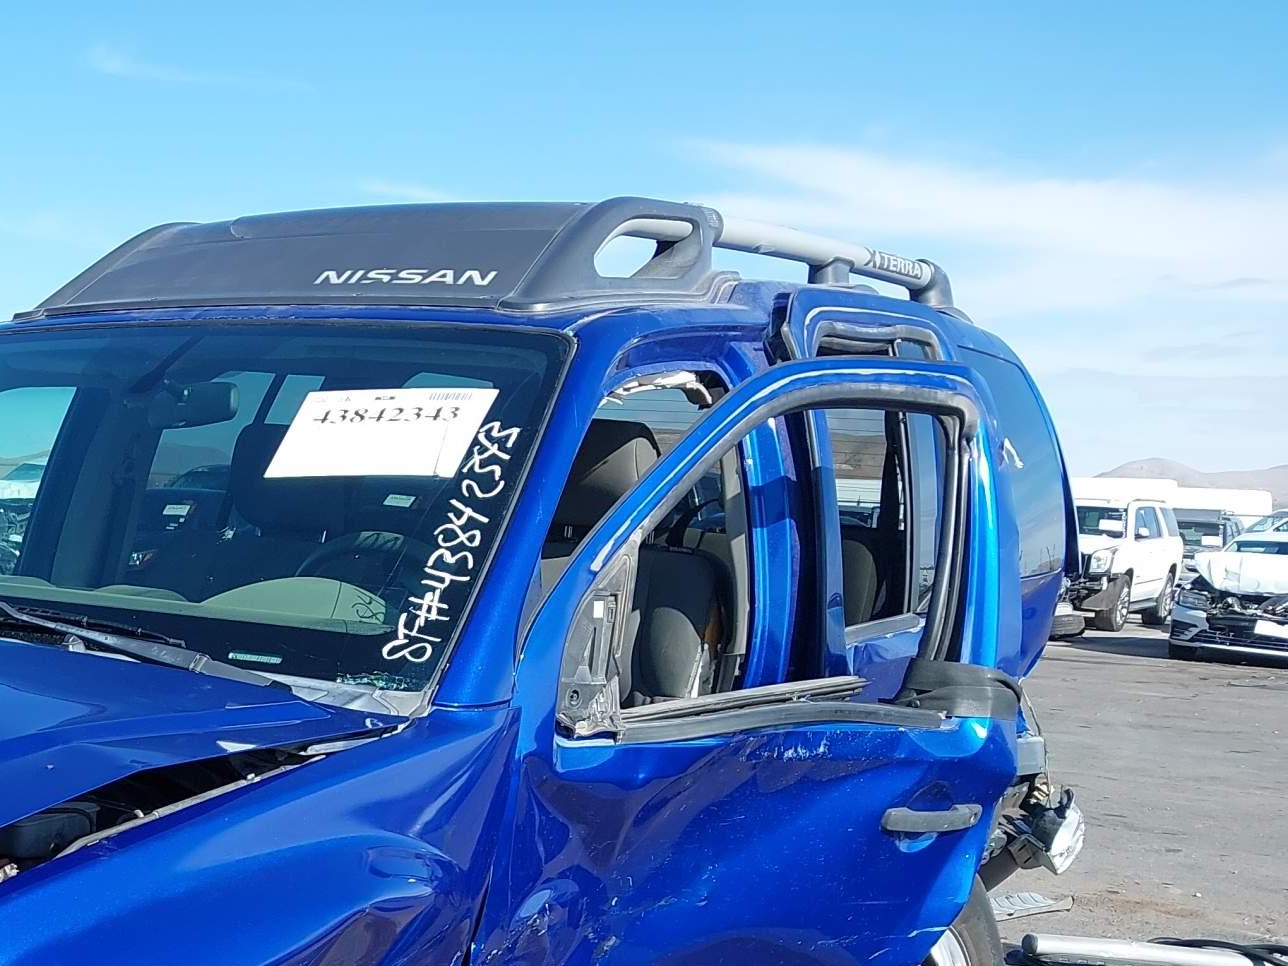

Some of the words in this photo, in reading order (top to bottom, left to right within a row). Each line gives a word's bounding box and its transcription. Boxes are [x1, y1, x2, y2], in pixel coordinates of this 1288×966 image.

[864, 246, 923, 279] XTERRA
[313, 269, 499, 287] NISSAN
[312, 406, 461, 424] 43842343
